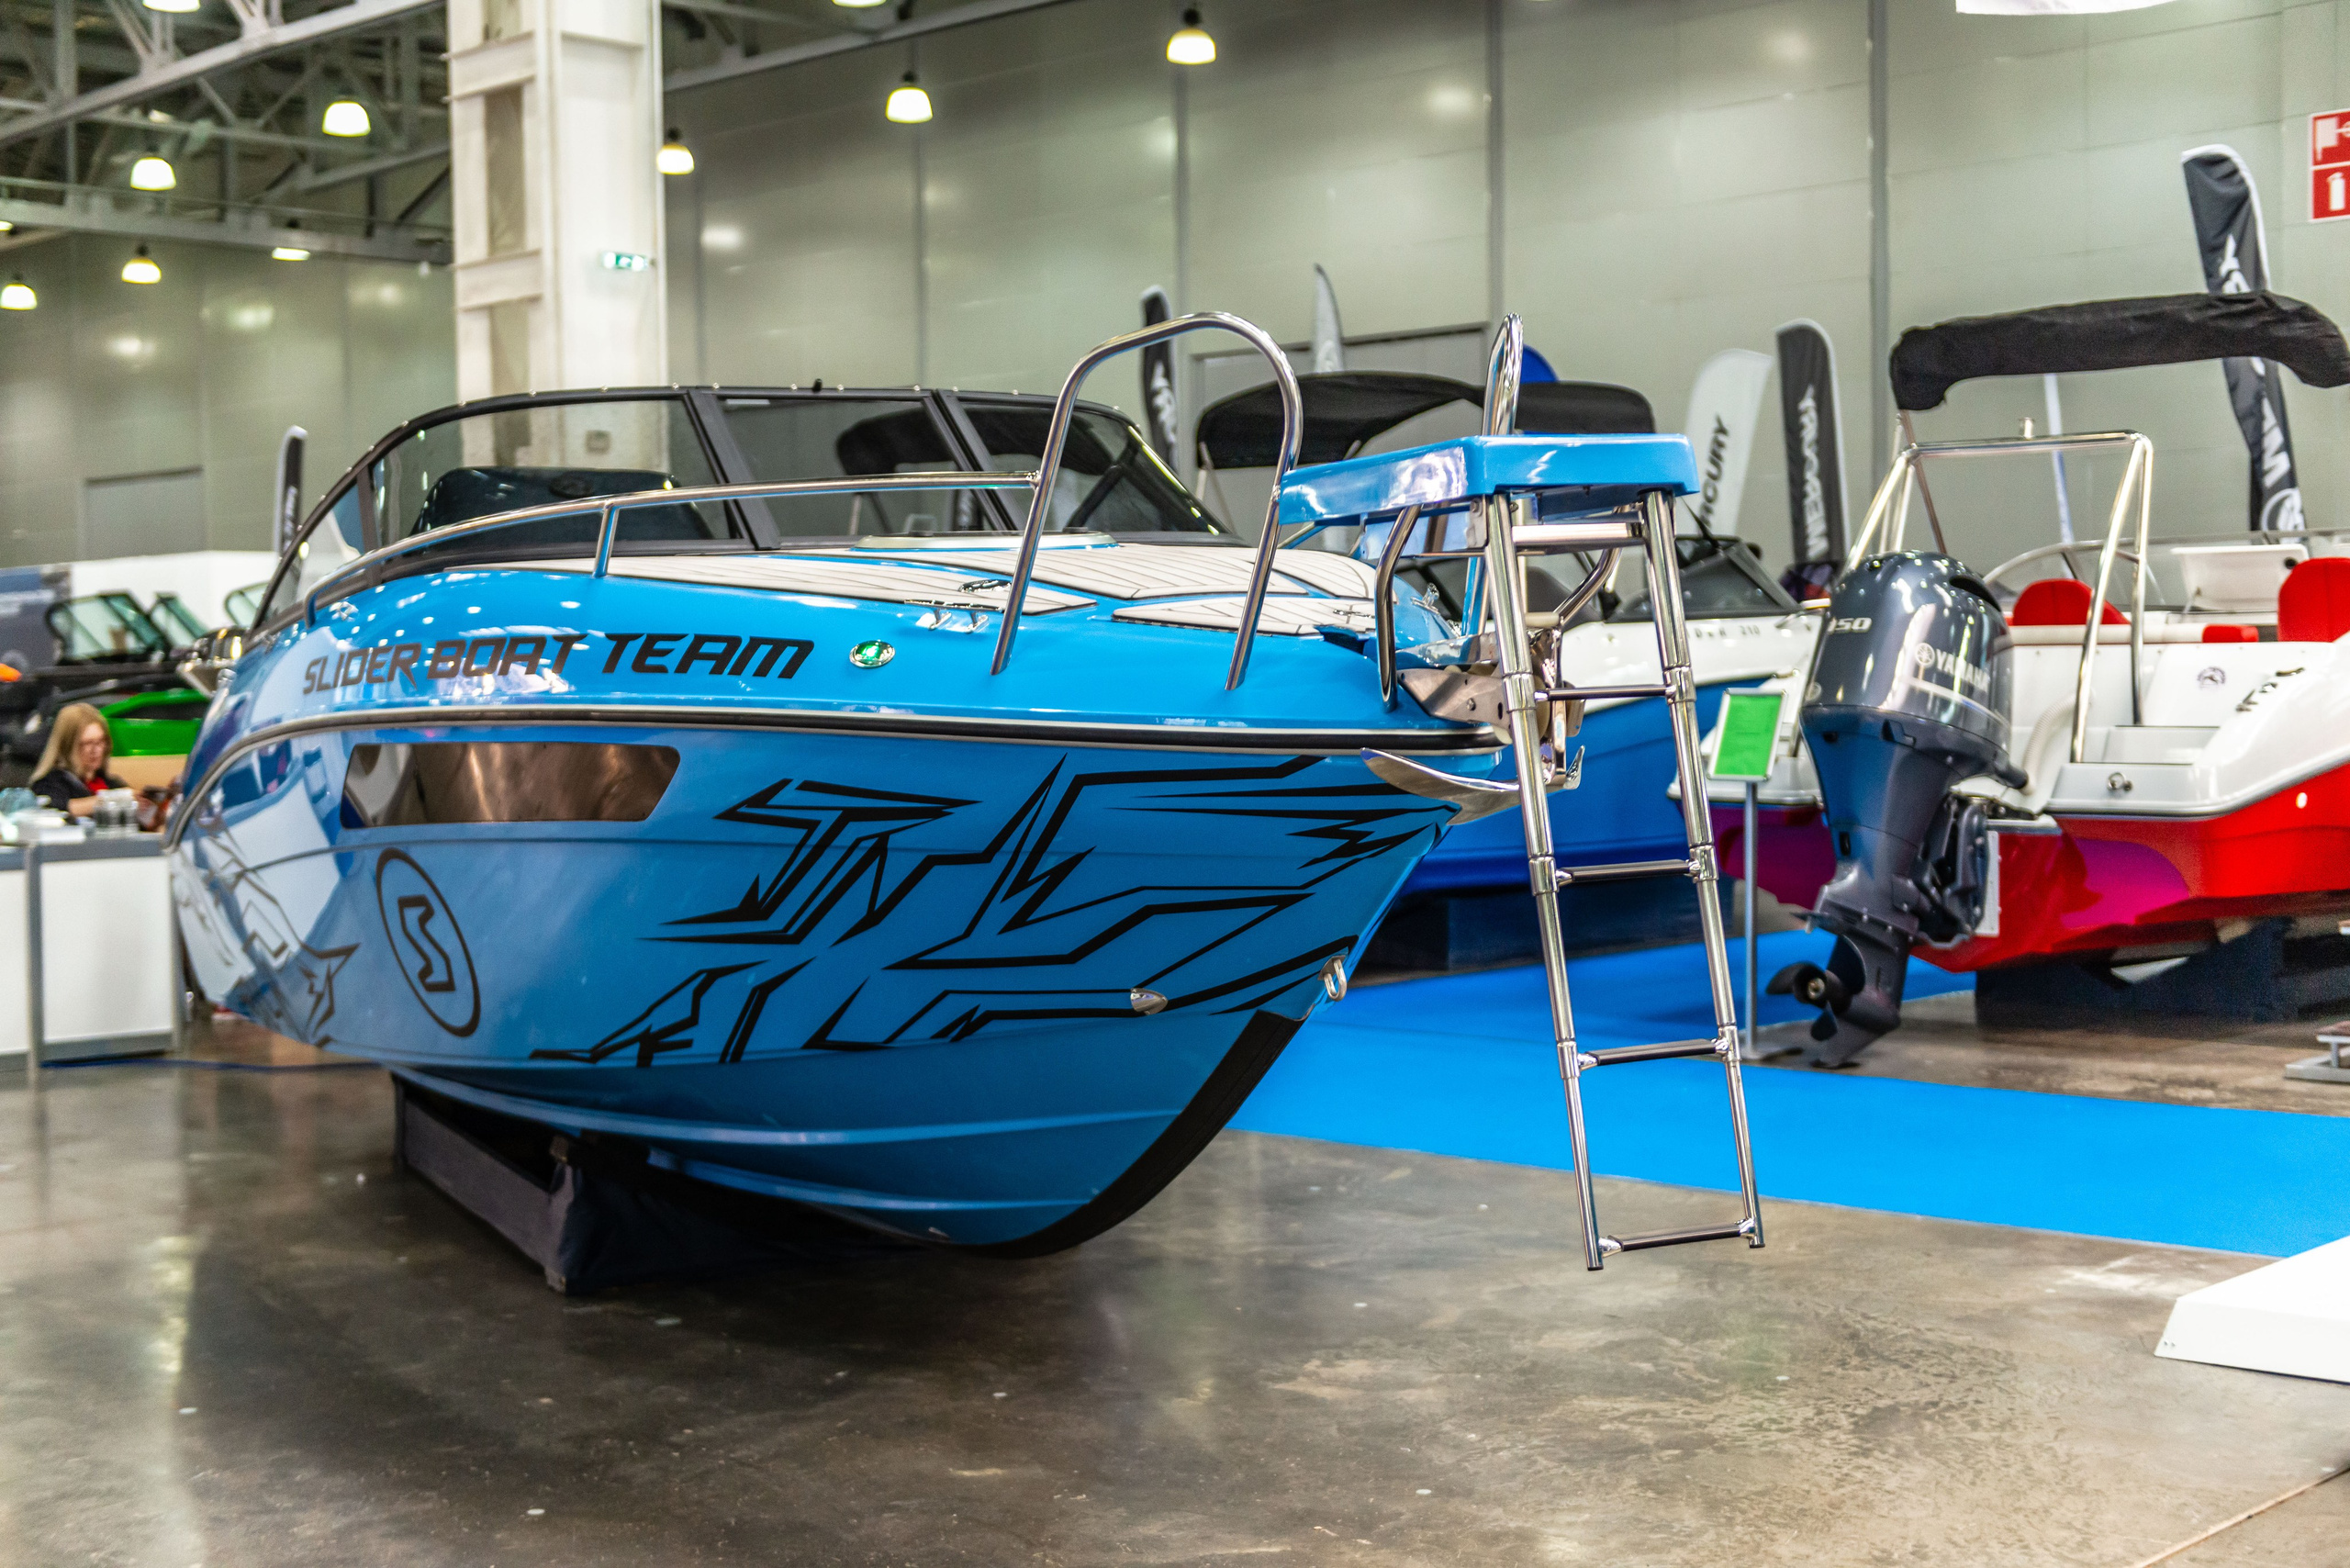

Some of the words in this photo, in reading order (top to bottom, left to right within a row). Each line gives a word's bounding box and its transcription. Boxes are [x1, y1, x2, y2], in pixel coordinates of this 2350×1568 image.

[302, 642, 422, 695] SLIDER
[427, 633, 589, 679] BOAT
[601, 633, 815, 680] TEAM
